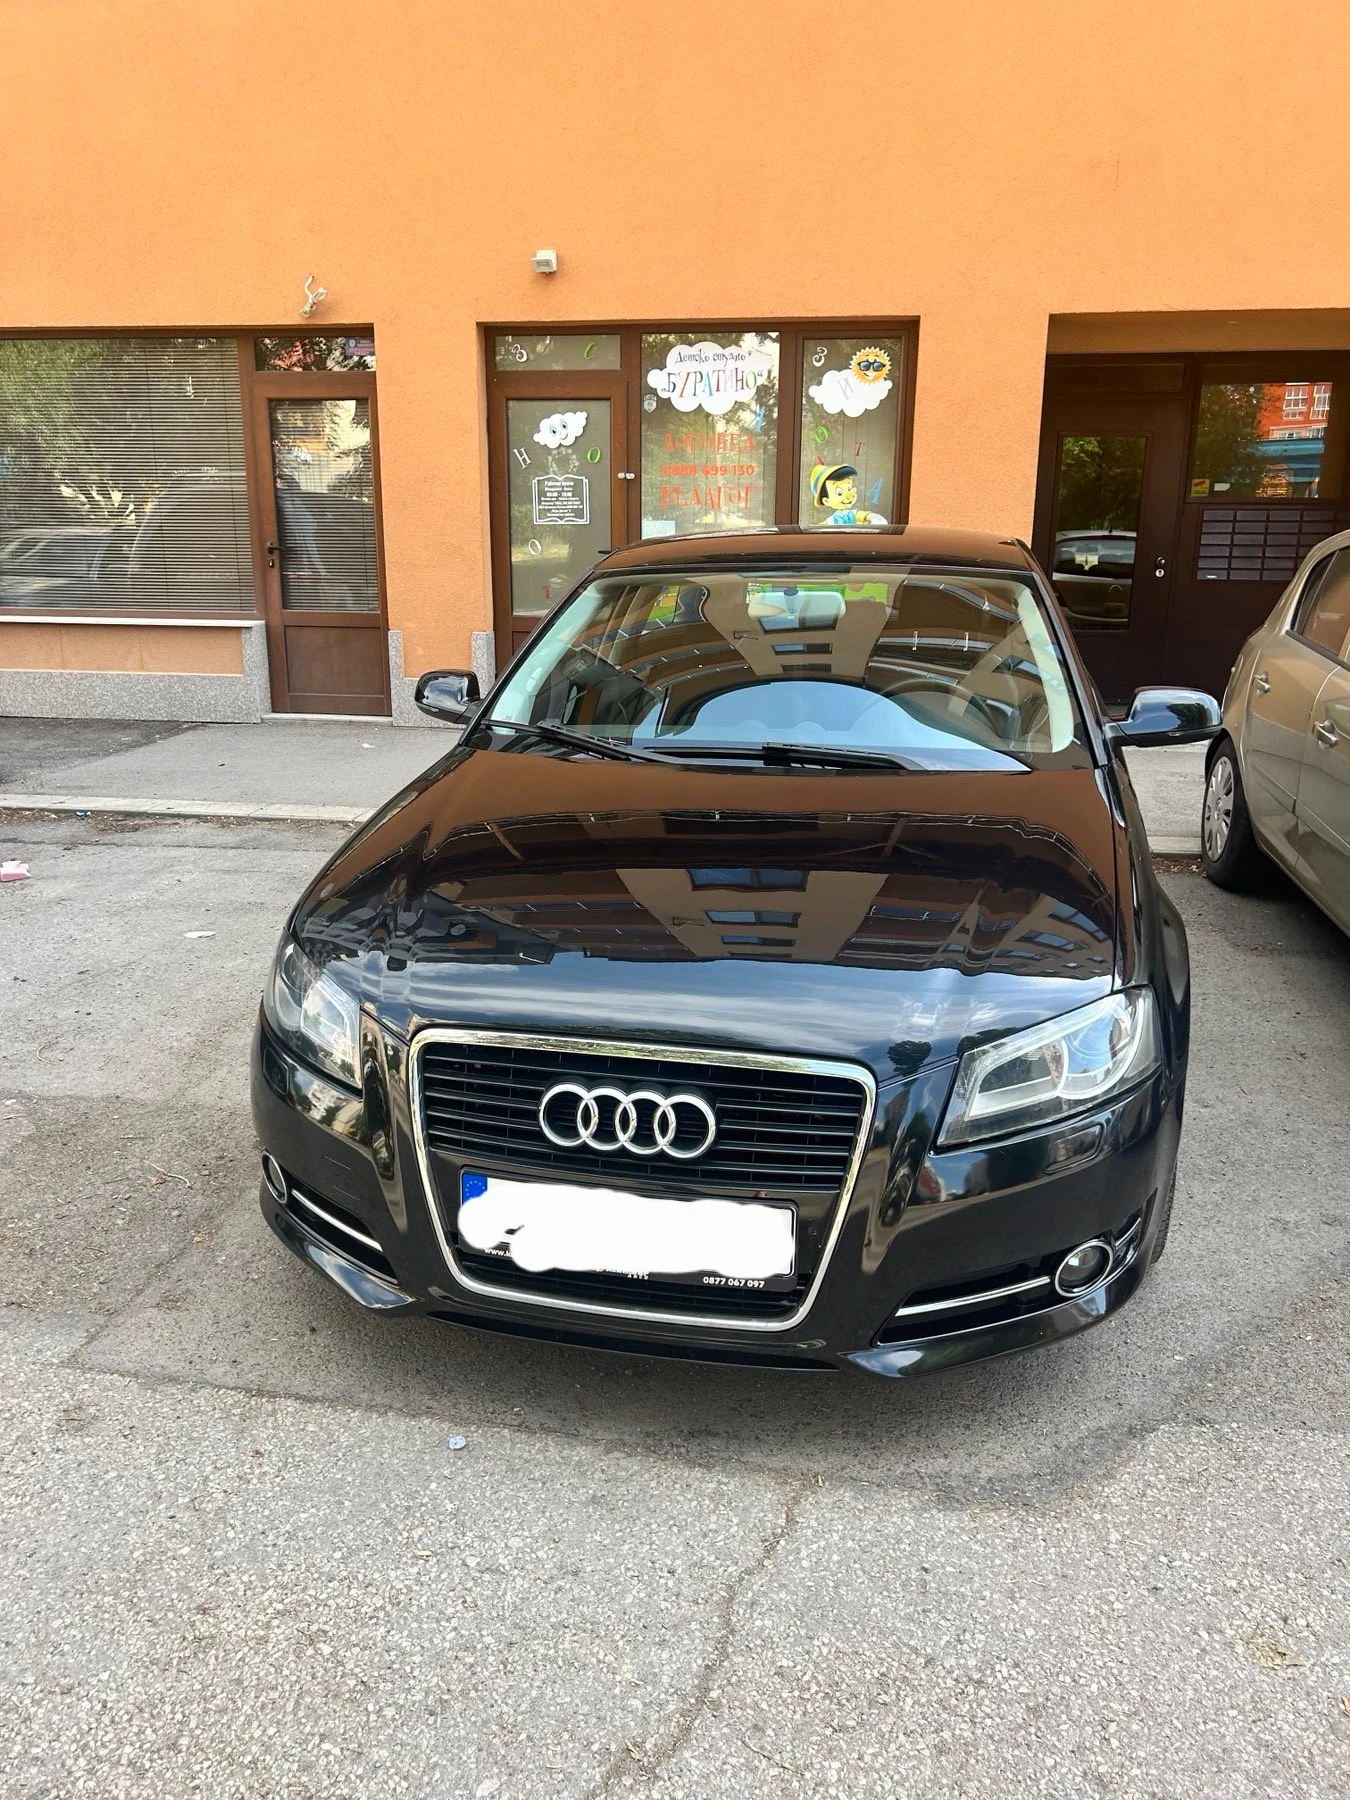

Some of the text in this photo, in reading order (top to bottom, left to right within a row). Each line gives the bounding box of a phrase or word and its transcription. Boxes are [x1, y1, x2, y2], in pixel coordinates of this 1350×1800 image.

[675, 348, 710, 364] Детско
[702, 463, 728, 476] 699
[732, 463, 756, 476] 130
[703, 1276, 765, 1289] 0877 067 097
